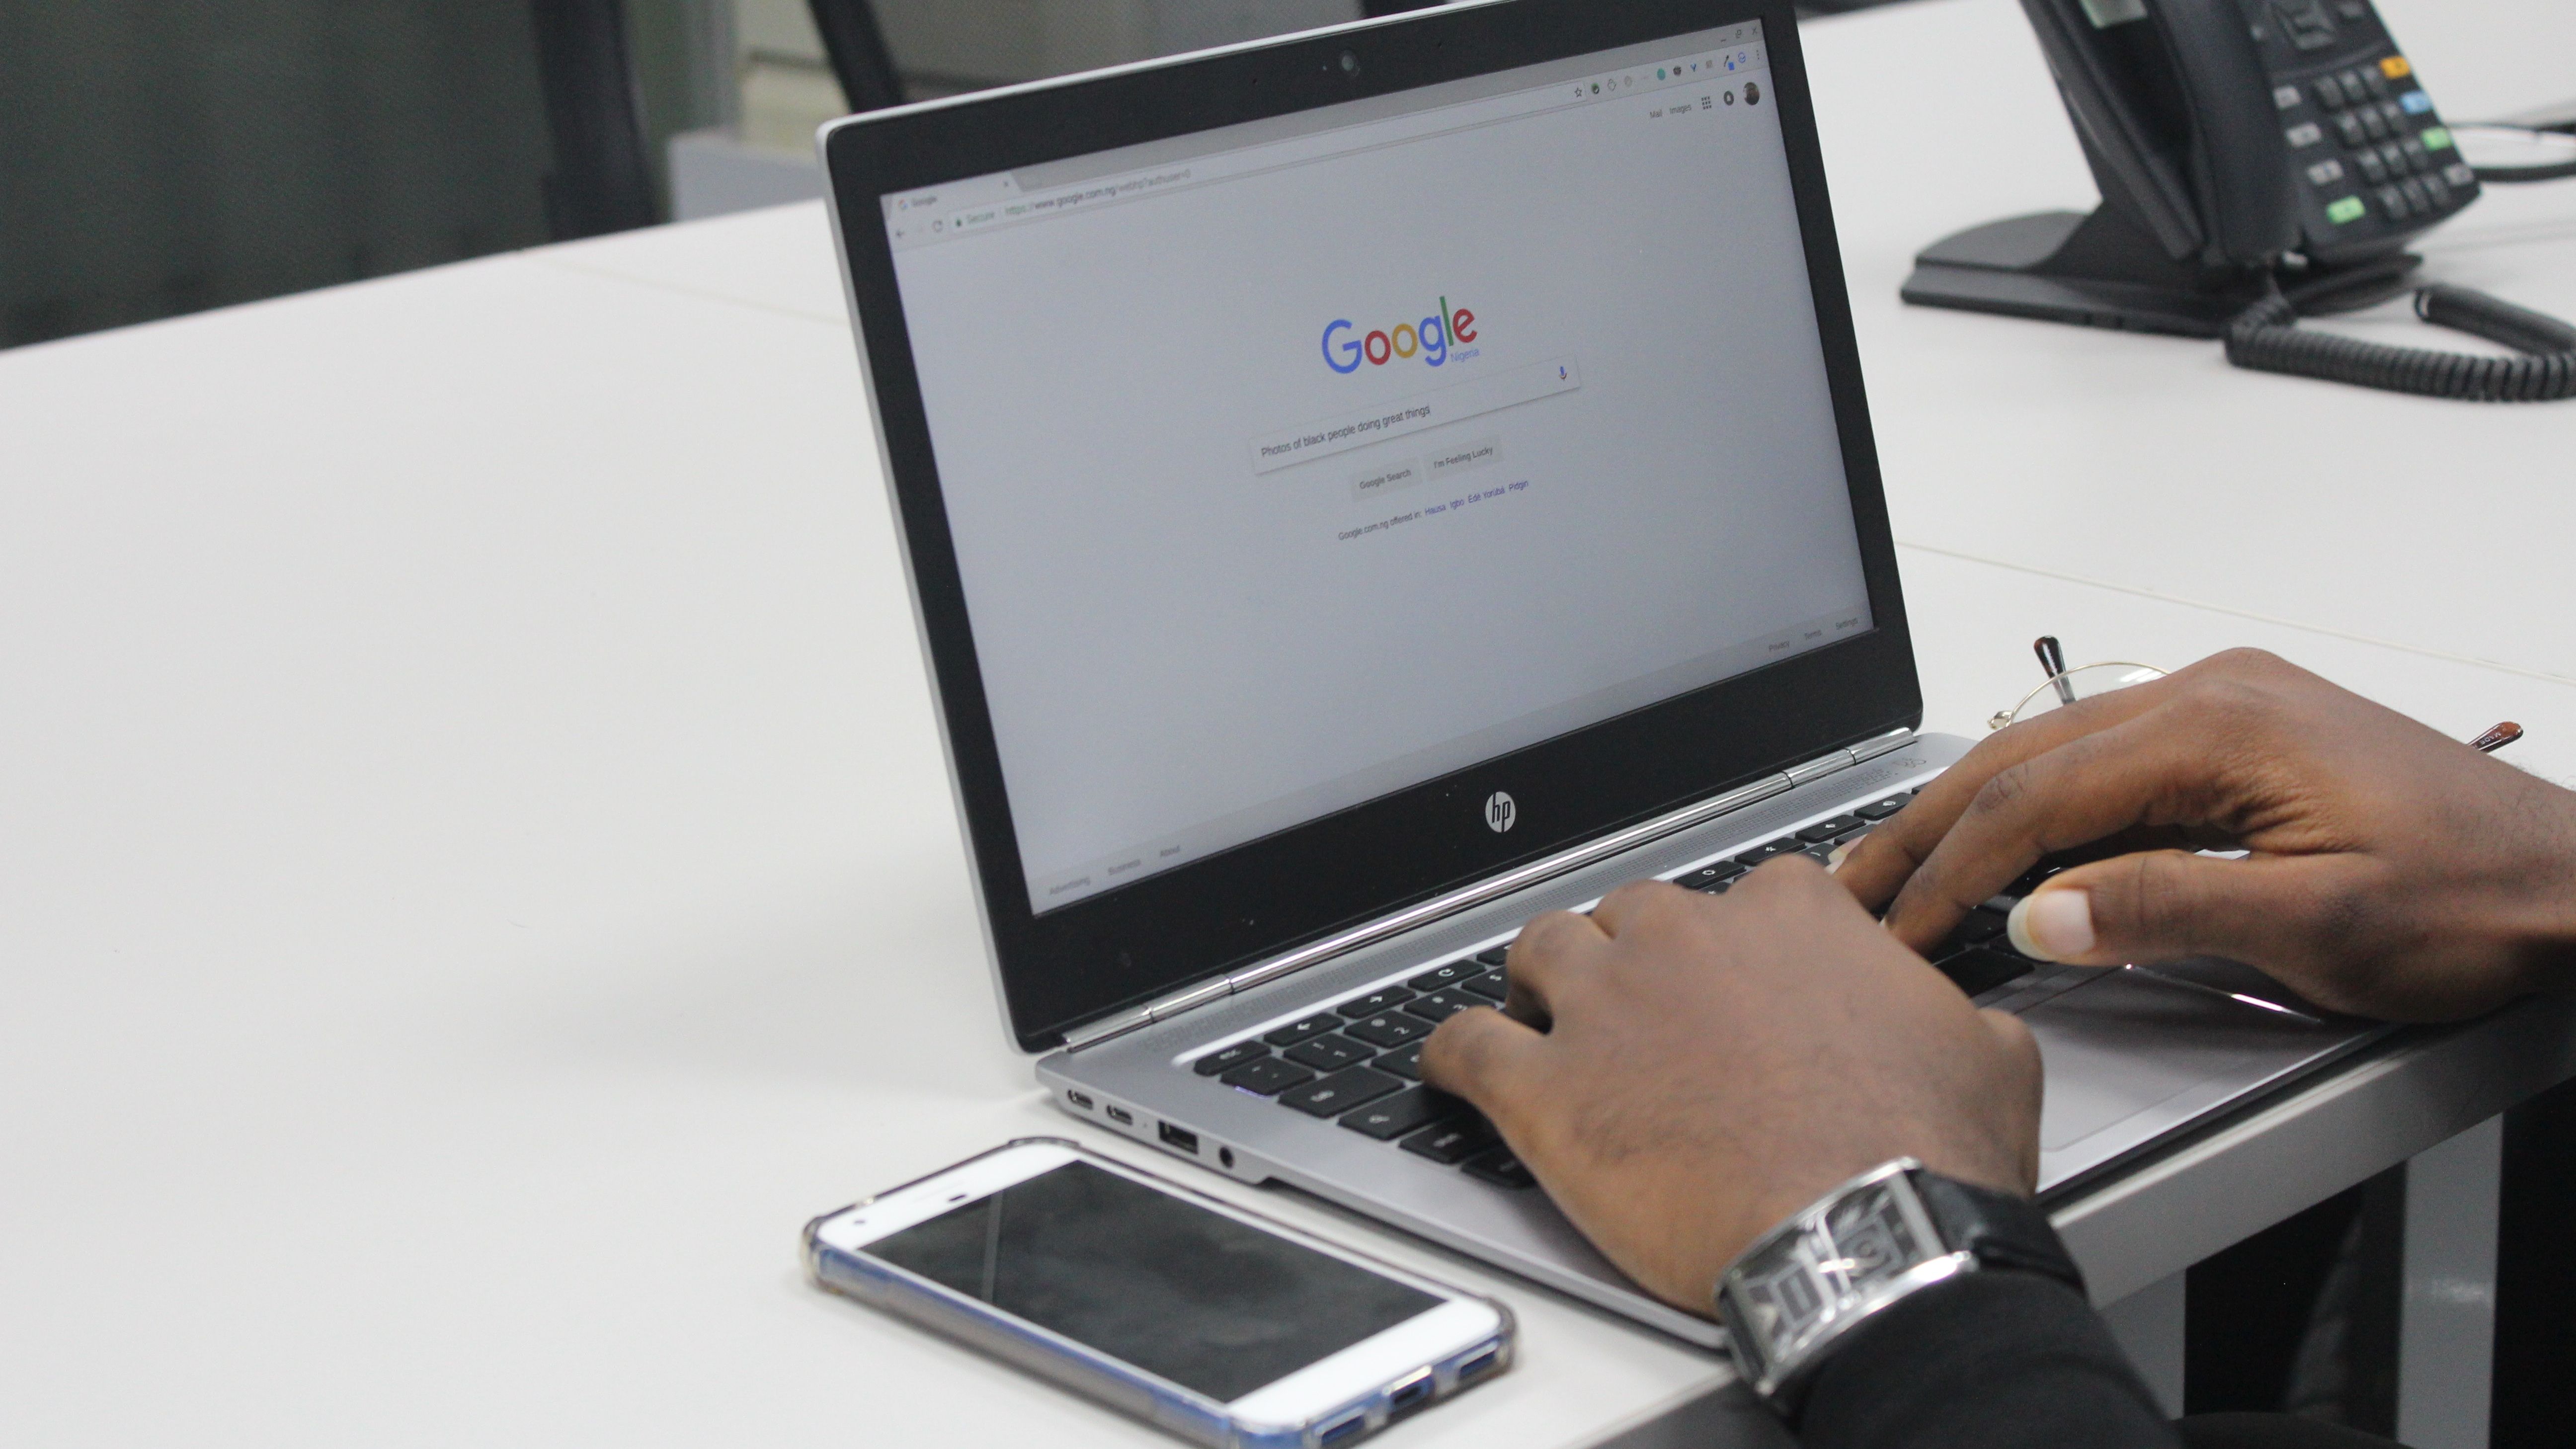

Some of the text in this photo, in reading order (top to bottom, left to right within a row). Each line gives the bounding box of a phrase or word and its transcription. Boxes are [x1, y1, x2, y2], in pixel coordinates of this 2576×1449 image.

[1649, 104, 1692, 119] Mail Images
[1322, 296, 1477, 374] Google
[1450, 348, 1480, 363] Nigeria
[1261, 404, 1430, 457] Photos of black people doing great things
[1446, 452, 1472, 466] Feeling
[1472, 446, 1493, 459] Lucky
[1359, 469, 1412, 489] Google Search
[1338, 520, 1388, 541] Google.com.ng
[1389, 512, 1413, 527] offered
[1425, 504, 1447, 516] Hausa
[1449, 498, 1465, 510] Igbo
[1509, 480, 1529, 491] Pidgin
[1491, 792, 1512, 833] hp
